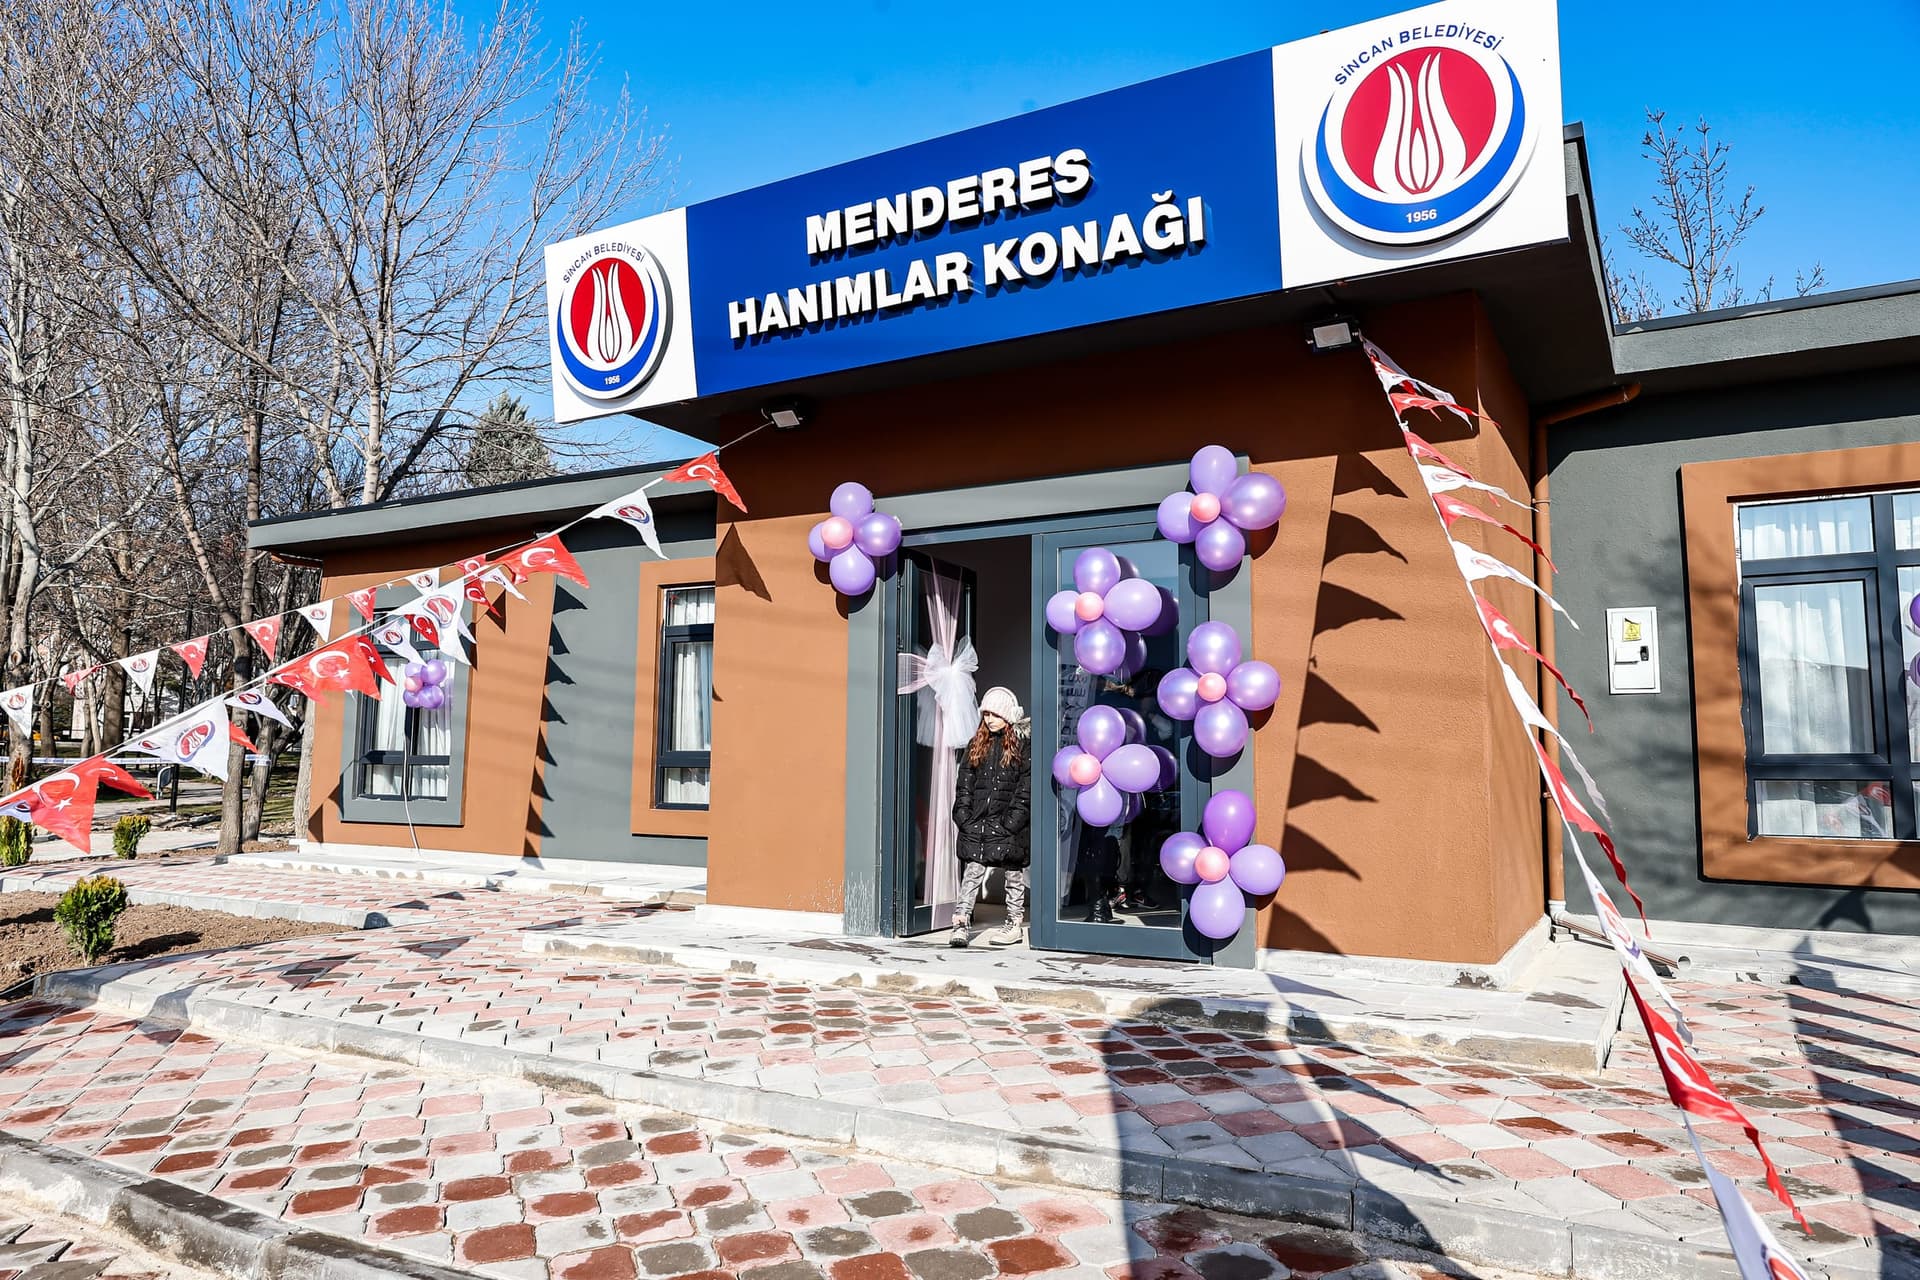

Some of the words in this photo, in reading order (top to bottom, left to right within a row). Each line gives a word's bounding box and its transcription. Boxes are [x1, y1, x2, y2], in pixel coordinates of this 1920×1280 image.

[1335, 37, 1394, 85] SİNCAN
[1399, 22, 1504, 51] BELEDİYESİ
[805, 148, 1090, 255] MENDERES
[1405, 209, 1437, 223] 1956
[727, 250, 970, 339] HANIMLAR
[983, 189, 1205, 286] KONAĞI
[604, 375, 620, 385] 1956
